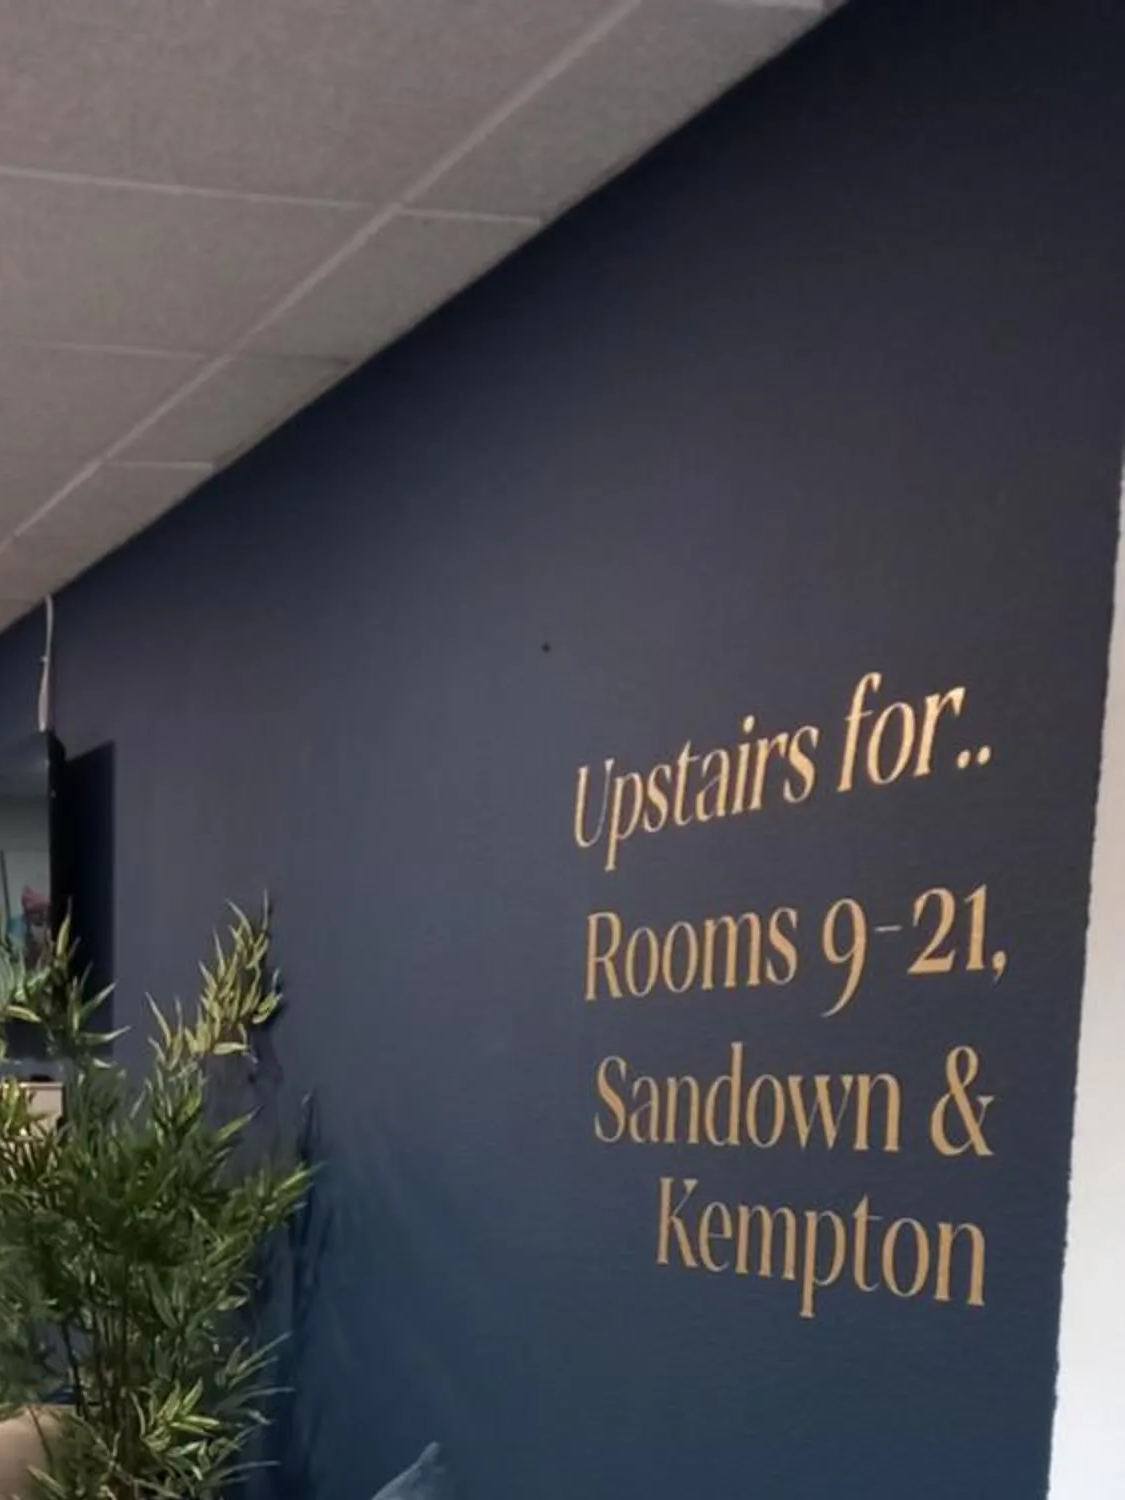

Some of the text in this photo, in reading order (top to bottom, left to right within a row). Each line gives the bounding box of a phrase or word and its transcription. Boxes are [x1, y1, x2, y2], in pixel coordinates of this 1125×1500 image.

[574, 671, 992, 872] Upstairs for..
[585, 884, 1008, 1018] Rooms 9-21,
[594, 1042, 995, 1157] Sandown &
[657, 1177, 987, 1318] Kempton
